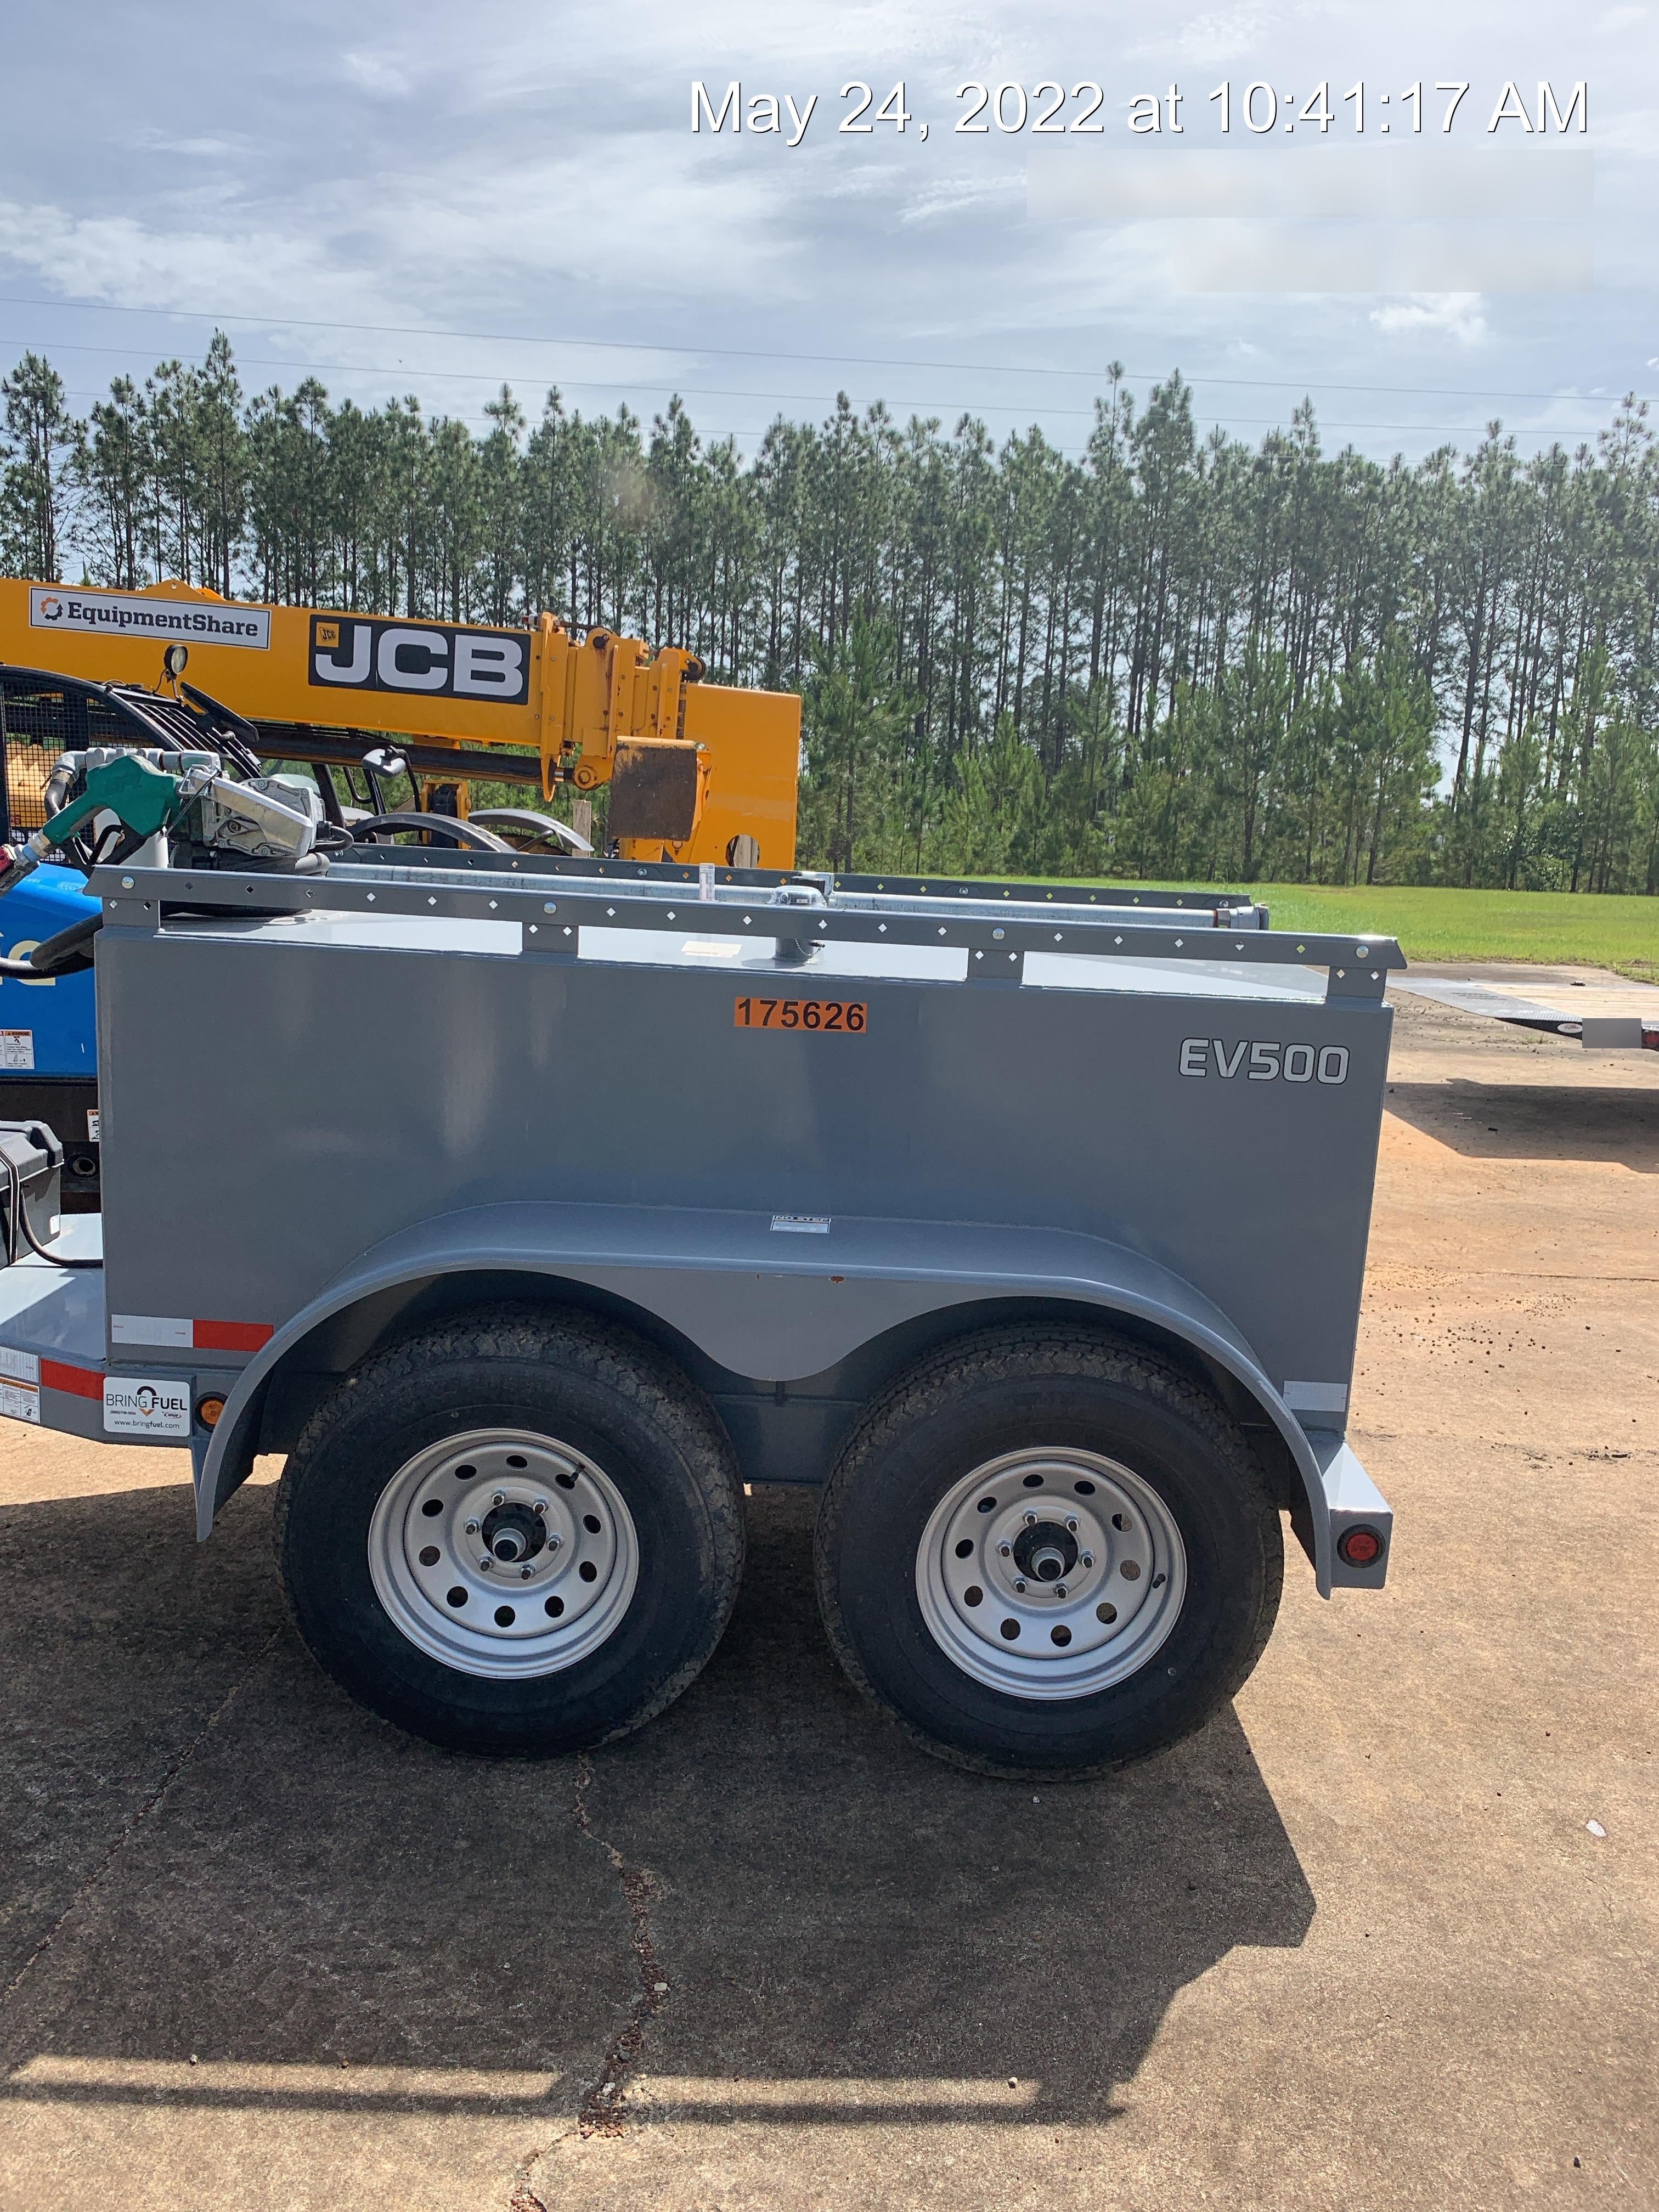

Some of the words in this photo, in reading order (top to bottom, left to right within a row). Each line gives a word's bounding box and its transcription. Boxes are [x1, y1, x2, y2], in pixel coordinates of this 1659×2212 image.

[67, 601, 258, 636] EquipmentShare
[321, 628, 336, 640] JCB
[315, 625, 523, 697] JCB
[738, 998, 864, 1031] 175626
[1178, 1037, 1350, 1085] EV500
[106, 1393, 147, 1408] BRING
[151, 1397, 188, 1410] FUEL
[114, 1420, 180, 1429] www.bringfuel.com
